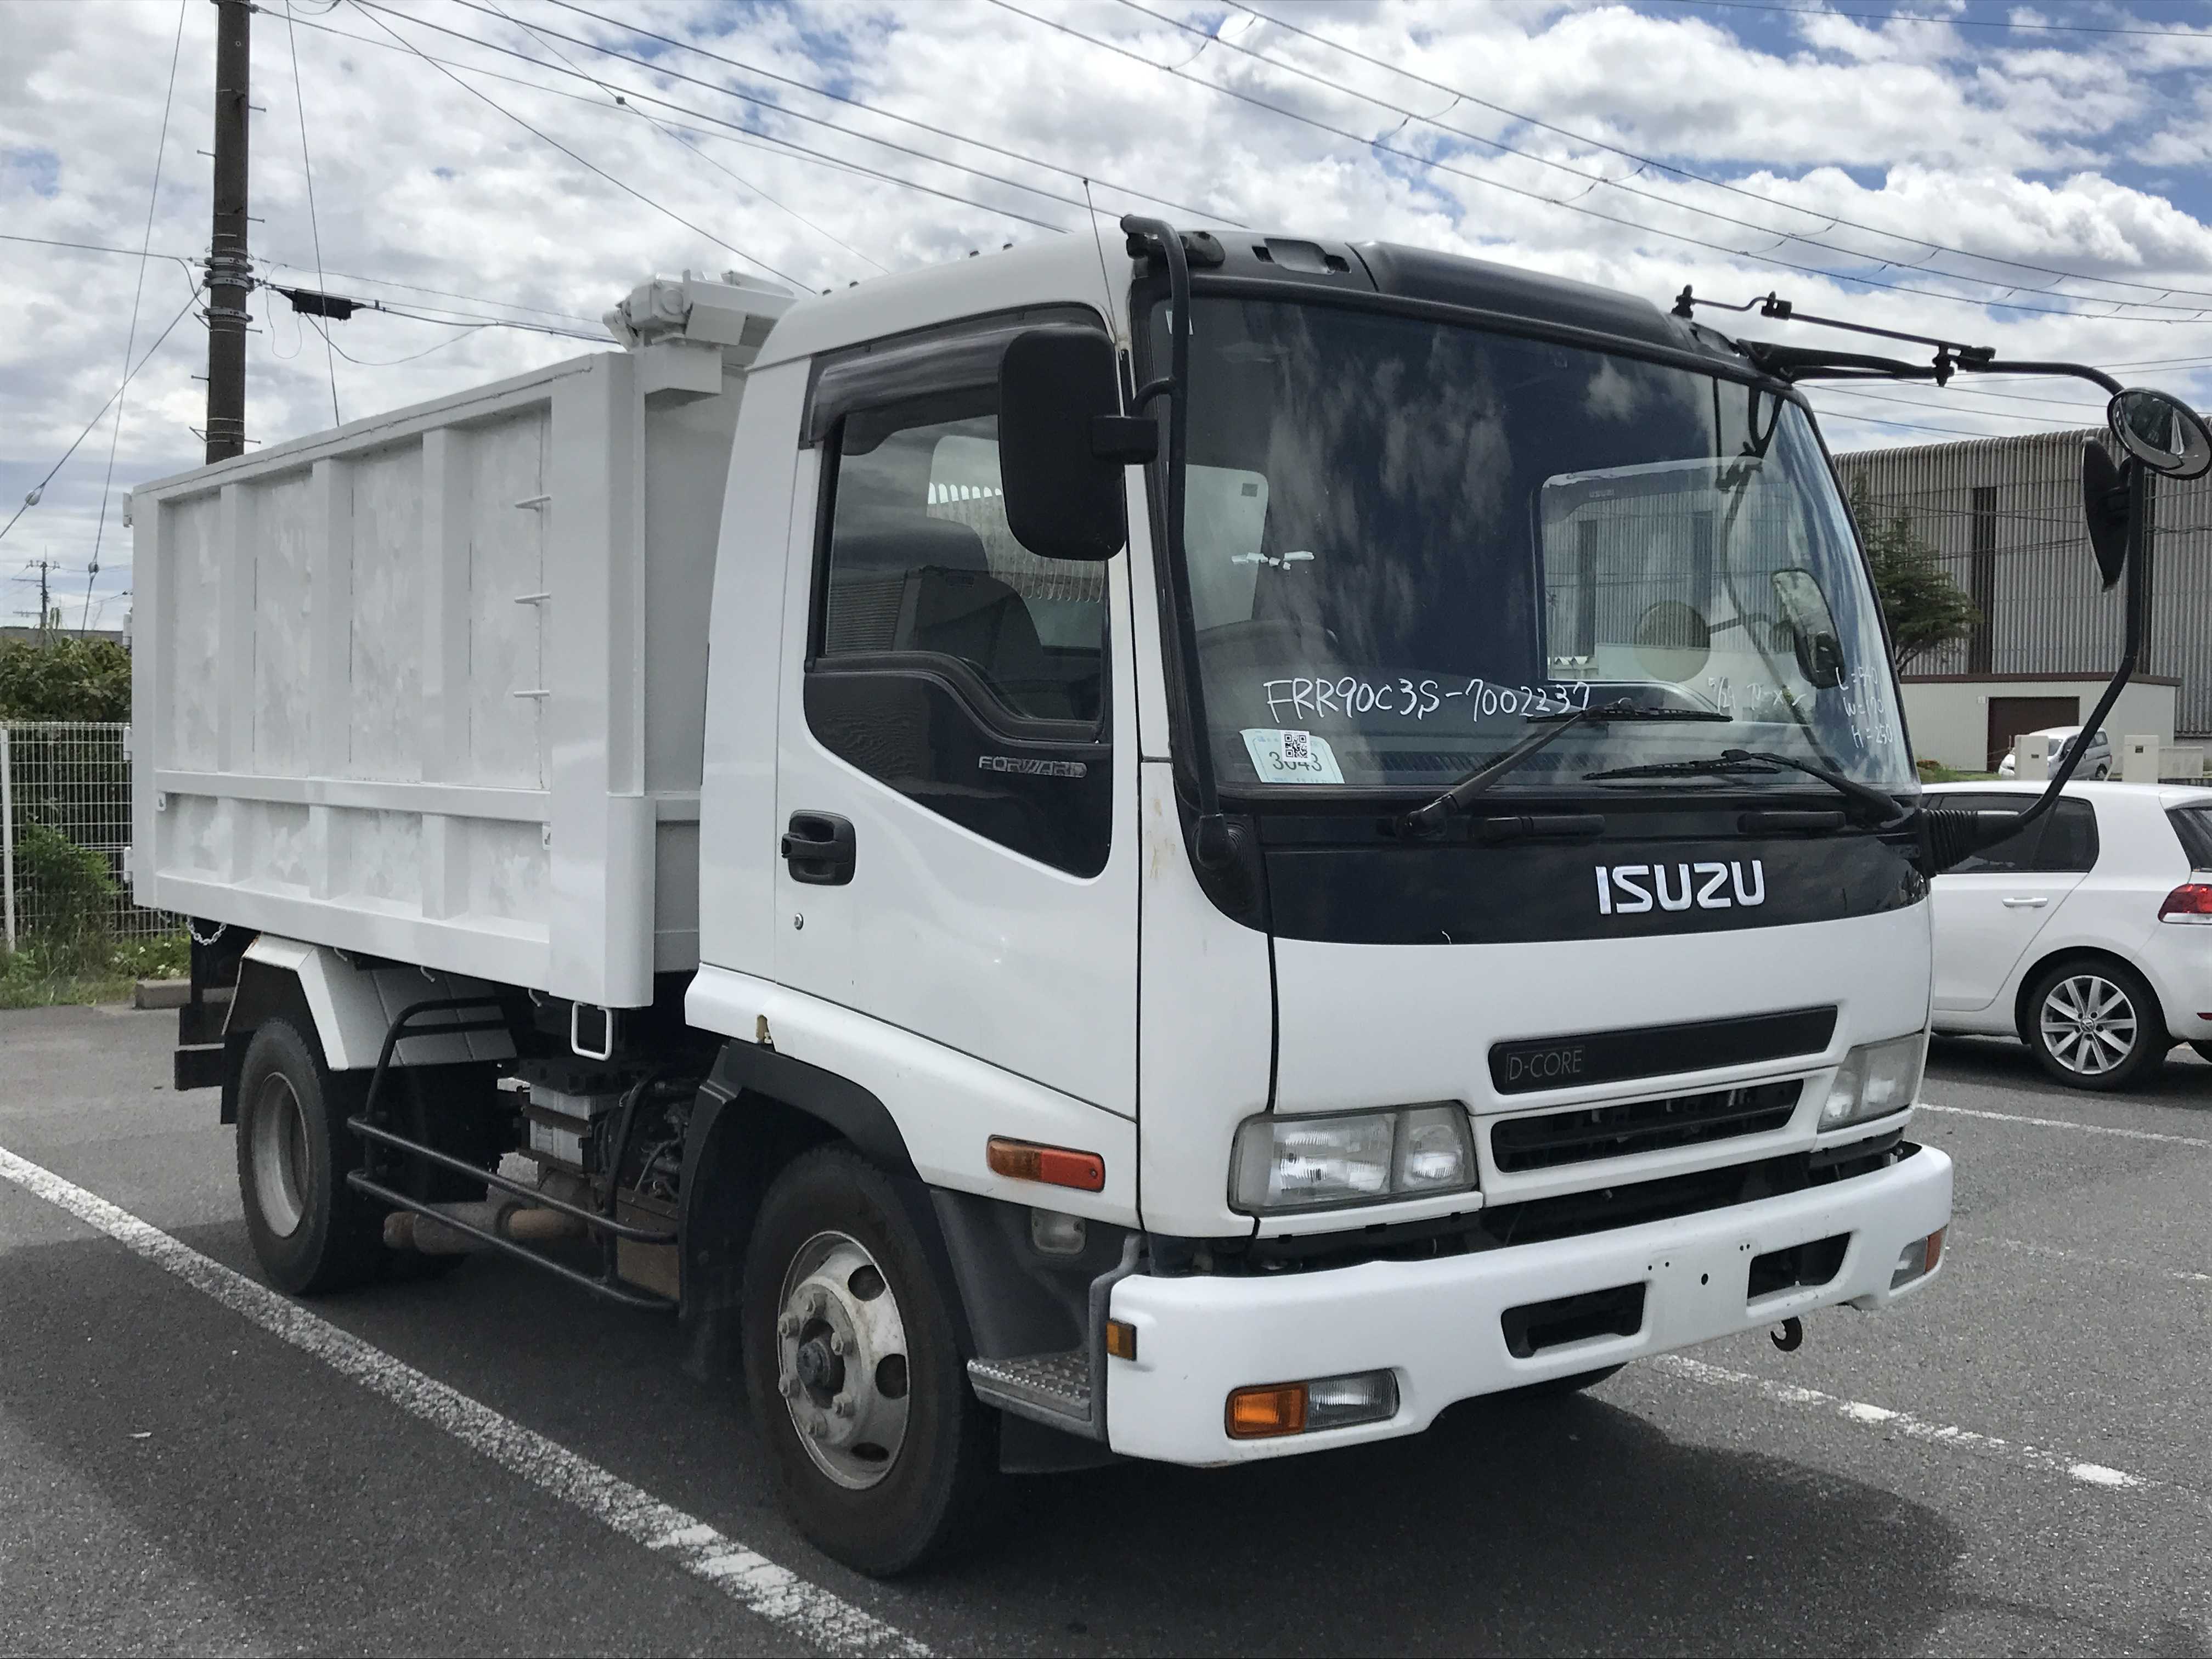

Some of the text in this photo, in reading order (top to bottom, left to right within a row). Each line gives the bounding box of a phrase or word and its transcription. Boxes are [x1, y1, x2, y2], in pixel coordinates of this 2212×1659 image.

[1263, 676, 1590, 723] FRR90C3S-7002237
[978, 755, 1088, 778] FORWARD
[1595, 860, 1765, 915] ISUZU
[1509, 1049, 1582, 1080] D-CORE
